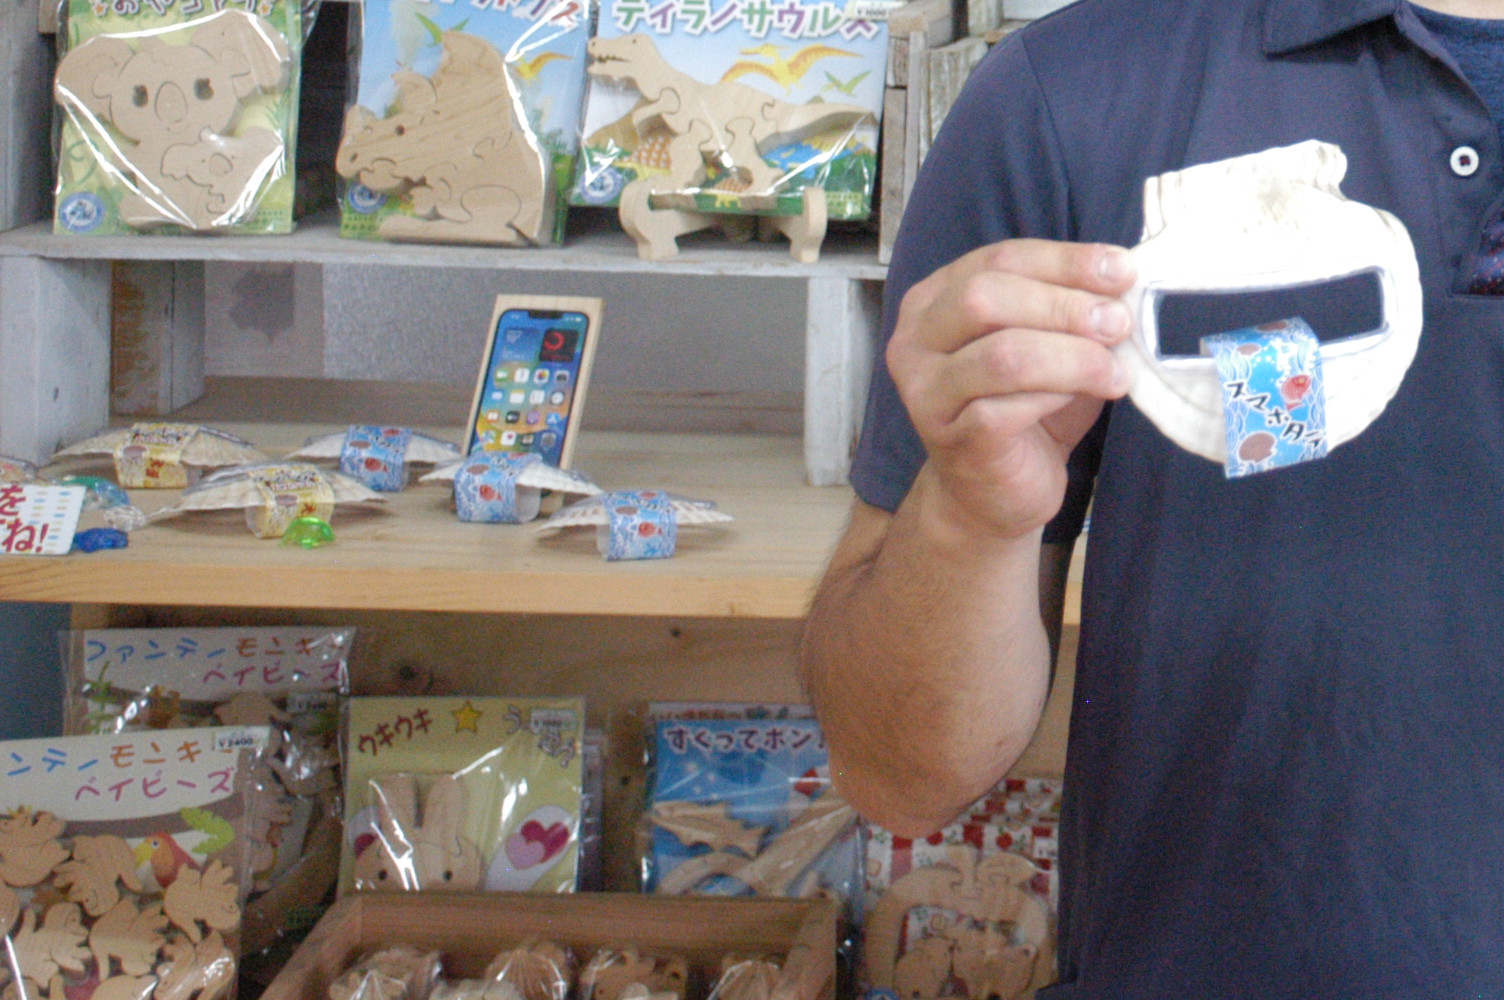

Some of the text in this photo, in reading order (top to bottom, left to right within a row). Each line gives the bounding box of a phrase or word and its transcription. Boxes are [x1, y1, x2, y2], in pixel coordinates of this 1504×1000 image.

[1226, 380, 1323, 450] スマホタテ
[358, 708, 433, 757] ウキウキ
[74, 768, 235, 801] ベイビーズ
